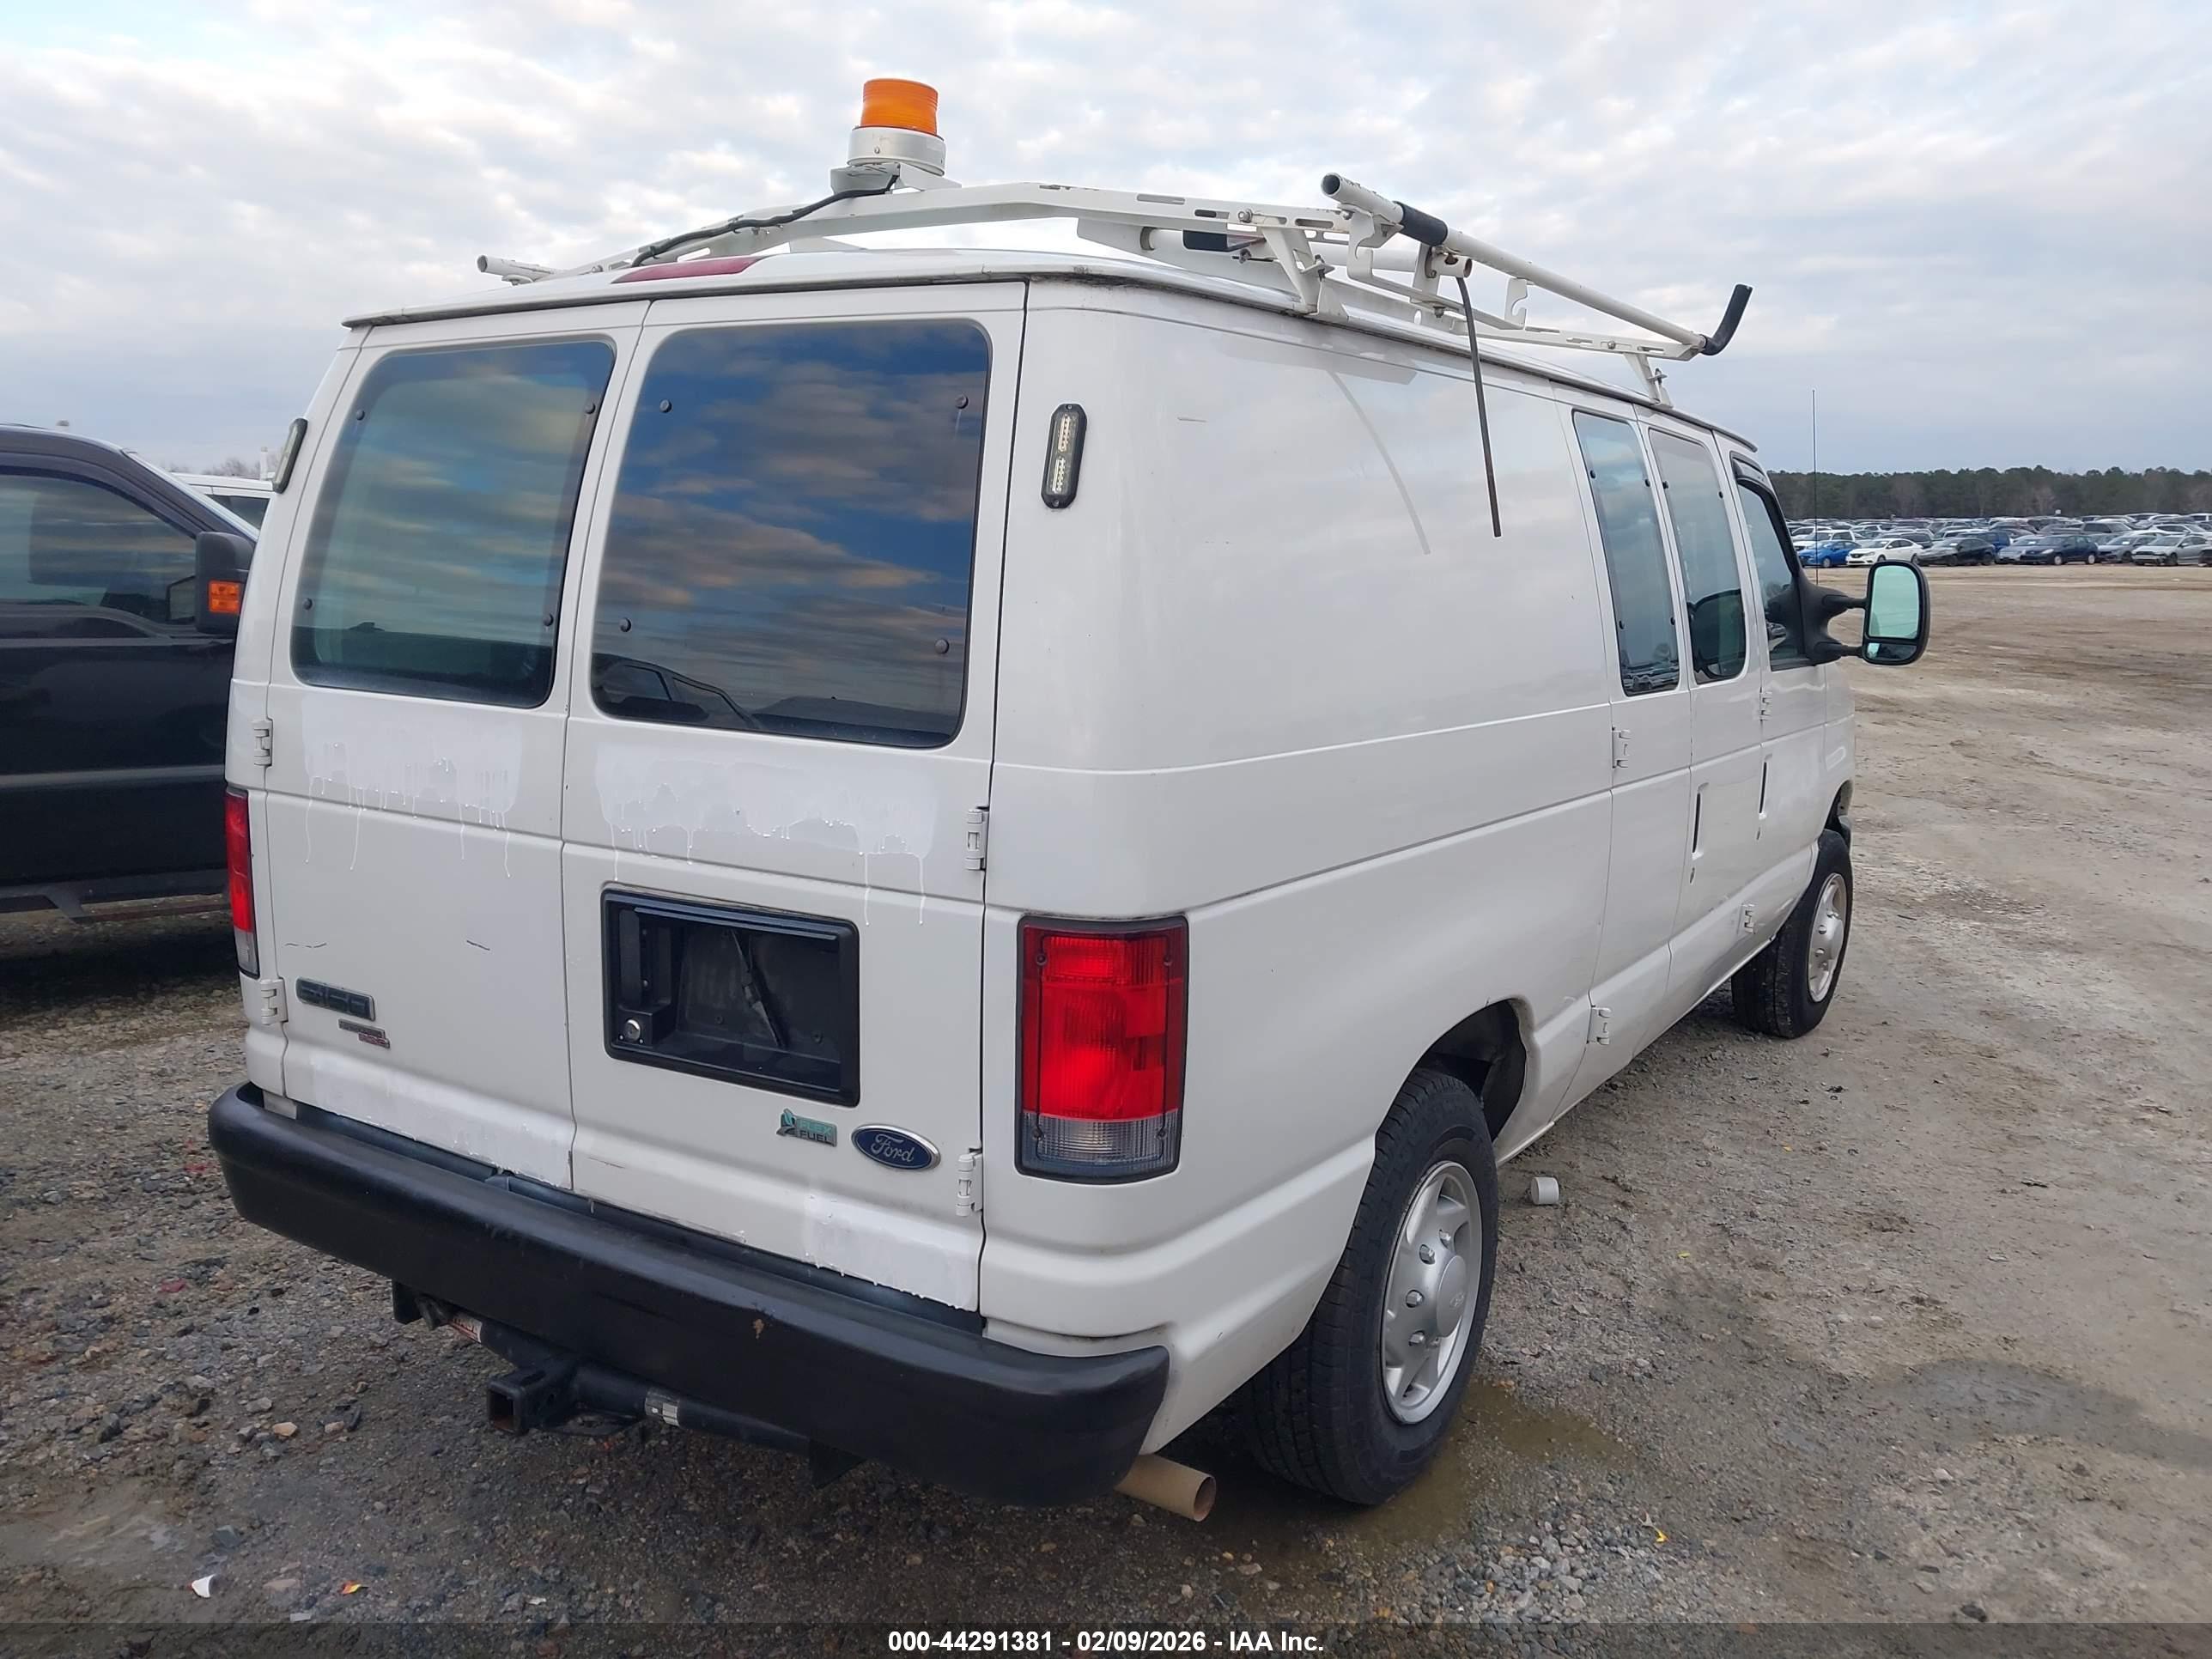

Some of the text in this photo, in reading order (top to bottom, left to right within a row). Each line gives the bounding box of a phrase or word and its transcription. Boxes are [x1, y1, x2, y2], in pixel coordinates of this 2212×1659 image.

[799, 1119, 832, 1135] FLEX
[799, 1130, 832, 1145] FUEL
[870, 1133, 915, 1164] Ford
